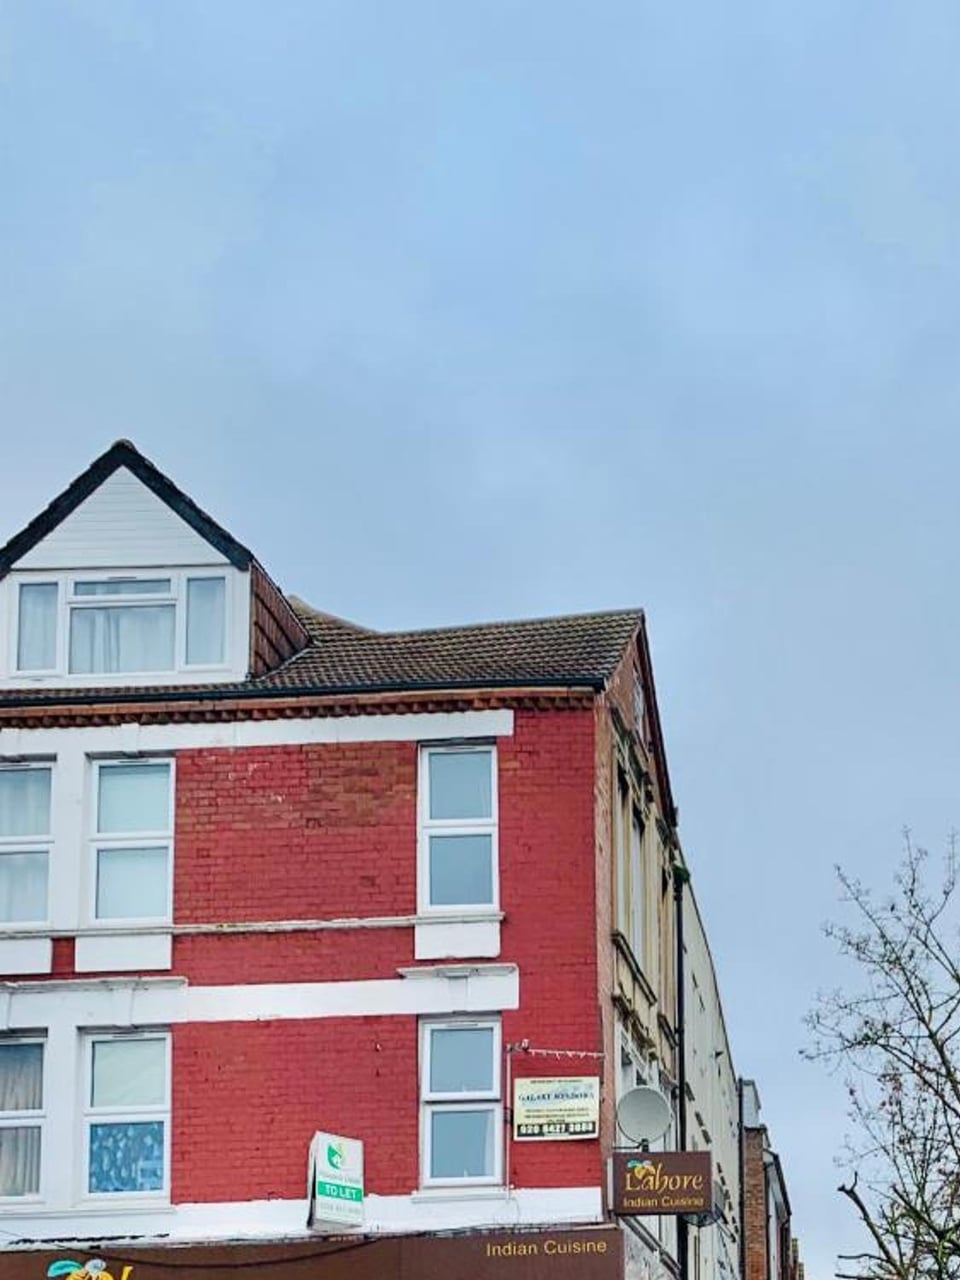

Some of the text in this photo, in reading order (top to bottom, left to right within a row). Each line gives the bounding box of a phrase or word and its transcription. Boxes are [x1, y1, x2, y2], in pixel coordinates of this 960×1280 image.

[625, 1162, 704, 1194] Lahore
[326, 1183, 358, 1200] TO LET
[623, 1196, 705, 1208] Indian Cuisine
[486, 1239, 608, 1257] Indian Cuisine
